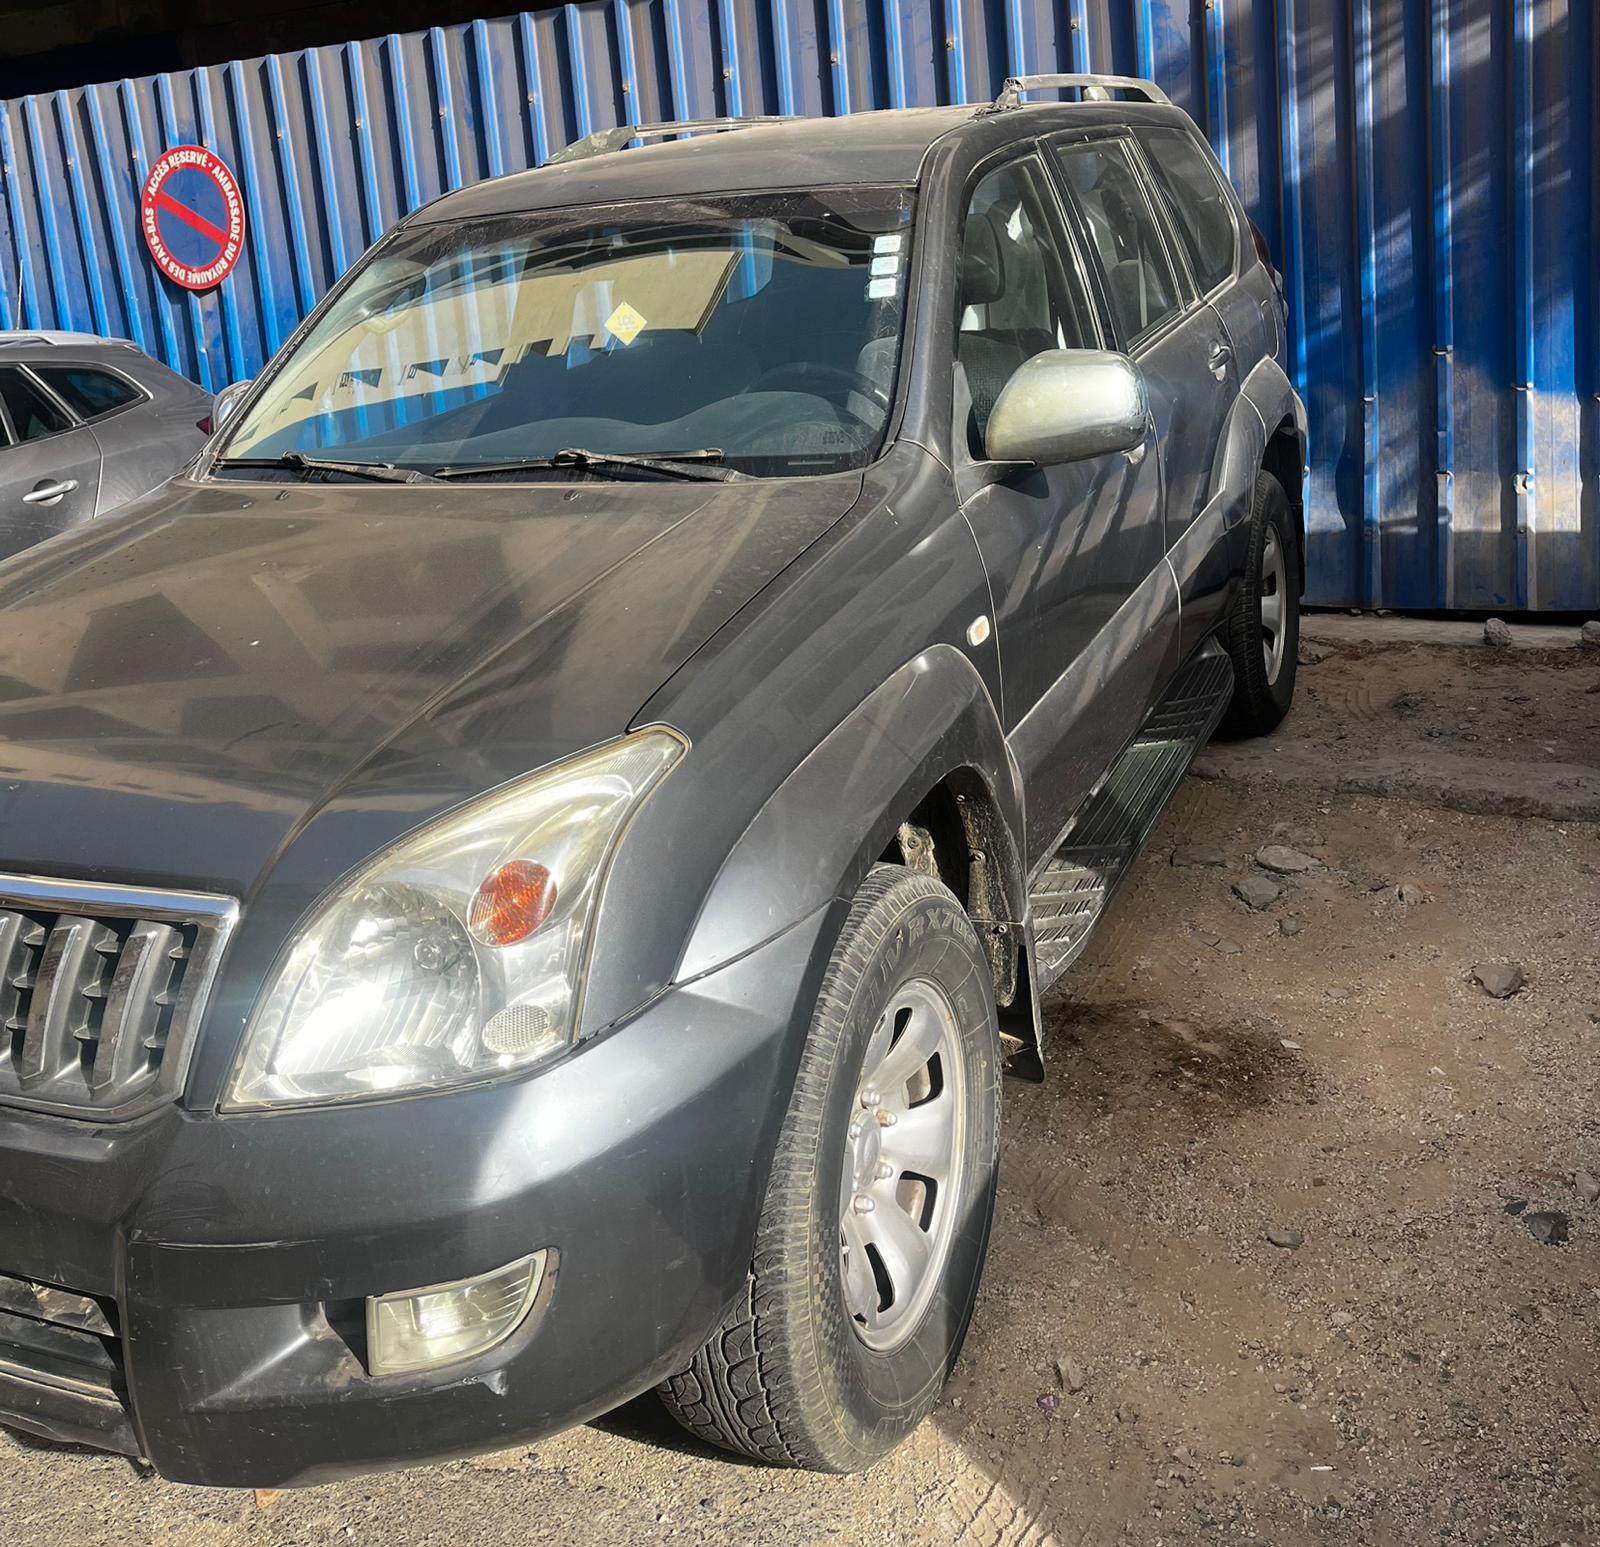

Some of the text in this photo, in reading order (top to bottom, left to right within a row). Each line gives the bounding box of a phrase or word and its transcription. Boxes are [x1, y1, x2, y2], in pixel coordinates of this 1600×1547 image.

[147, 160, 170, 197] ACCÈS
[145, 165, 241, 284] AMBASSADE DU ROYAUME DES PAYS-BAS
